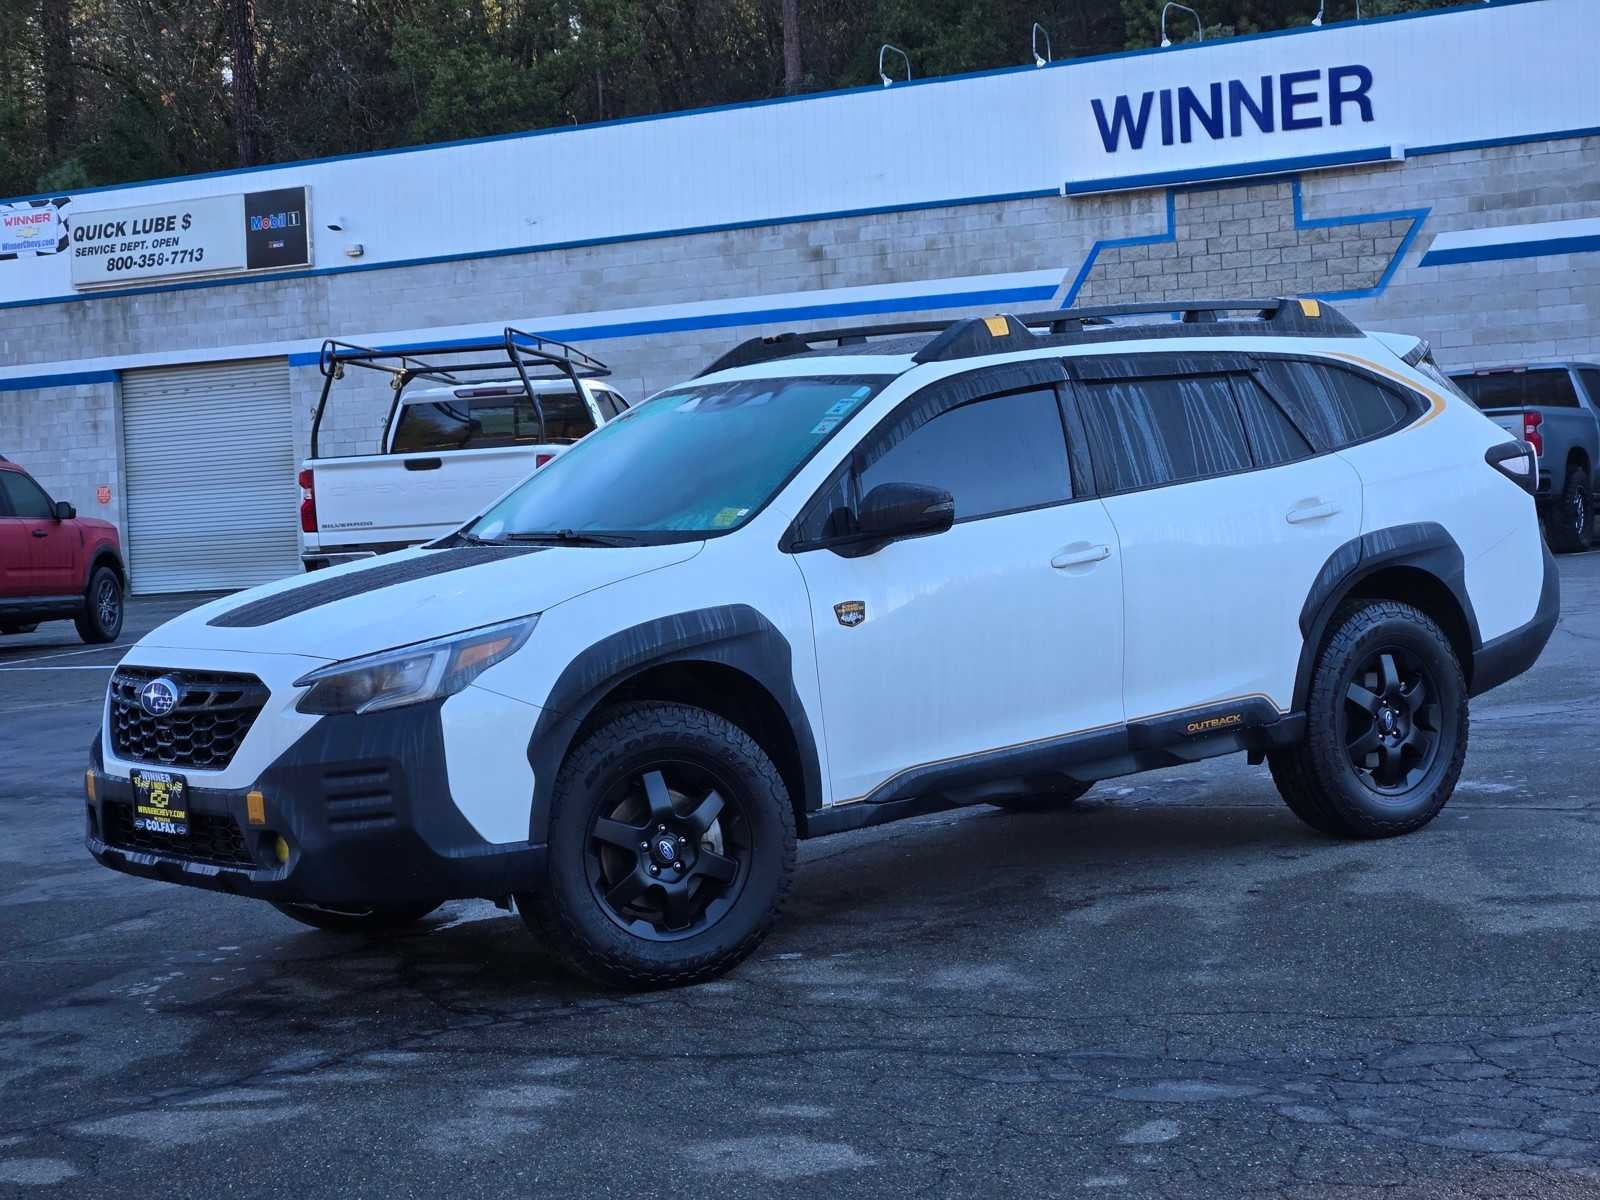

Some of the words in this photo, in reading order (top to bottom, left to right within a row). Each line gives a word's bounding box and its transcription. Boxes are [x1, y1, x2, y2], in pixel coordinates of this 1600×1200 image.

[1090, 64, 1374, 153] WINNER
[4, 213, 52, 227] WINNER
[73, 220, 127, 242] QUICK
[132, 215, 177, 235] LUBE
[181, 213, 192, 232] $
[250, 212, 286, 231] Mobil
[75, 243, 117, 257] SERVICE
[120, 240, 149, 252] DEPT.
[151, 237, 180, 249] OPEN
[106, 247, 205, 272] 800-358-7713
[321, 520, 374, 529] SILVERADO
[1187, 713, 1241, 732] OUTBACK
[140, 769, 171, 783] WINNER
[145, 818, 176, 834] COLFAX
